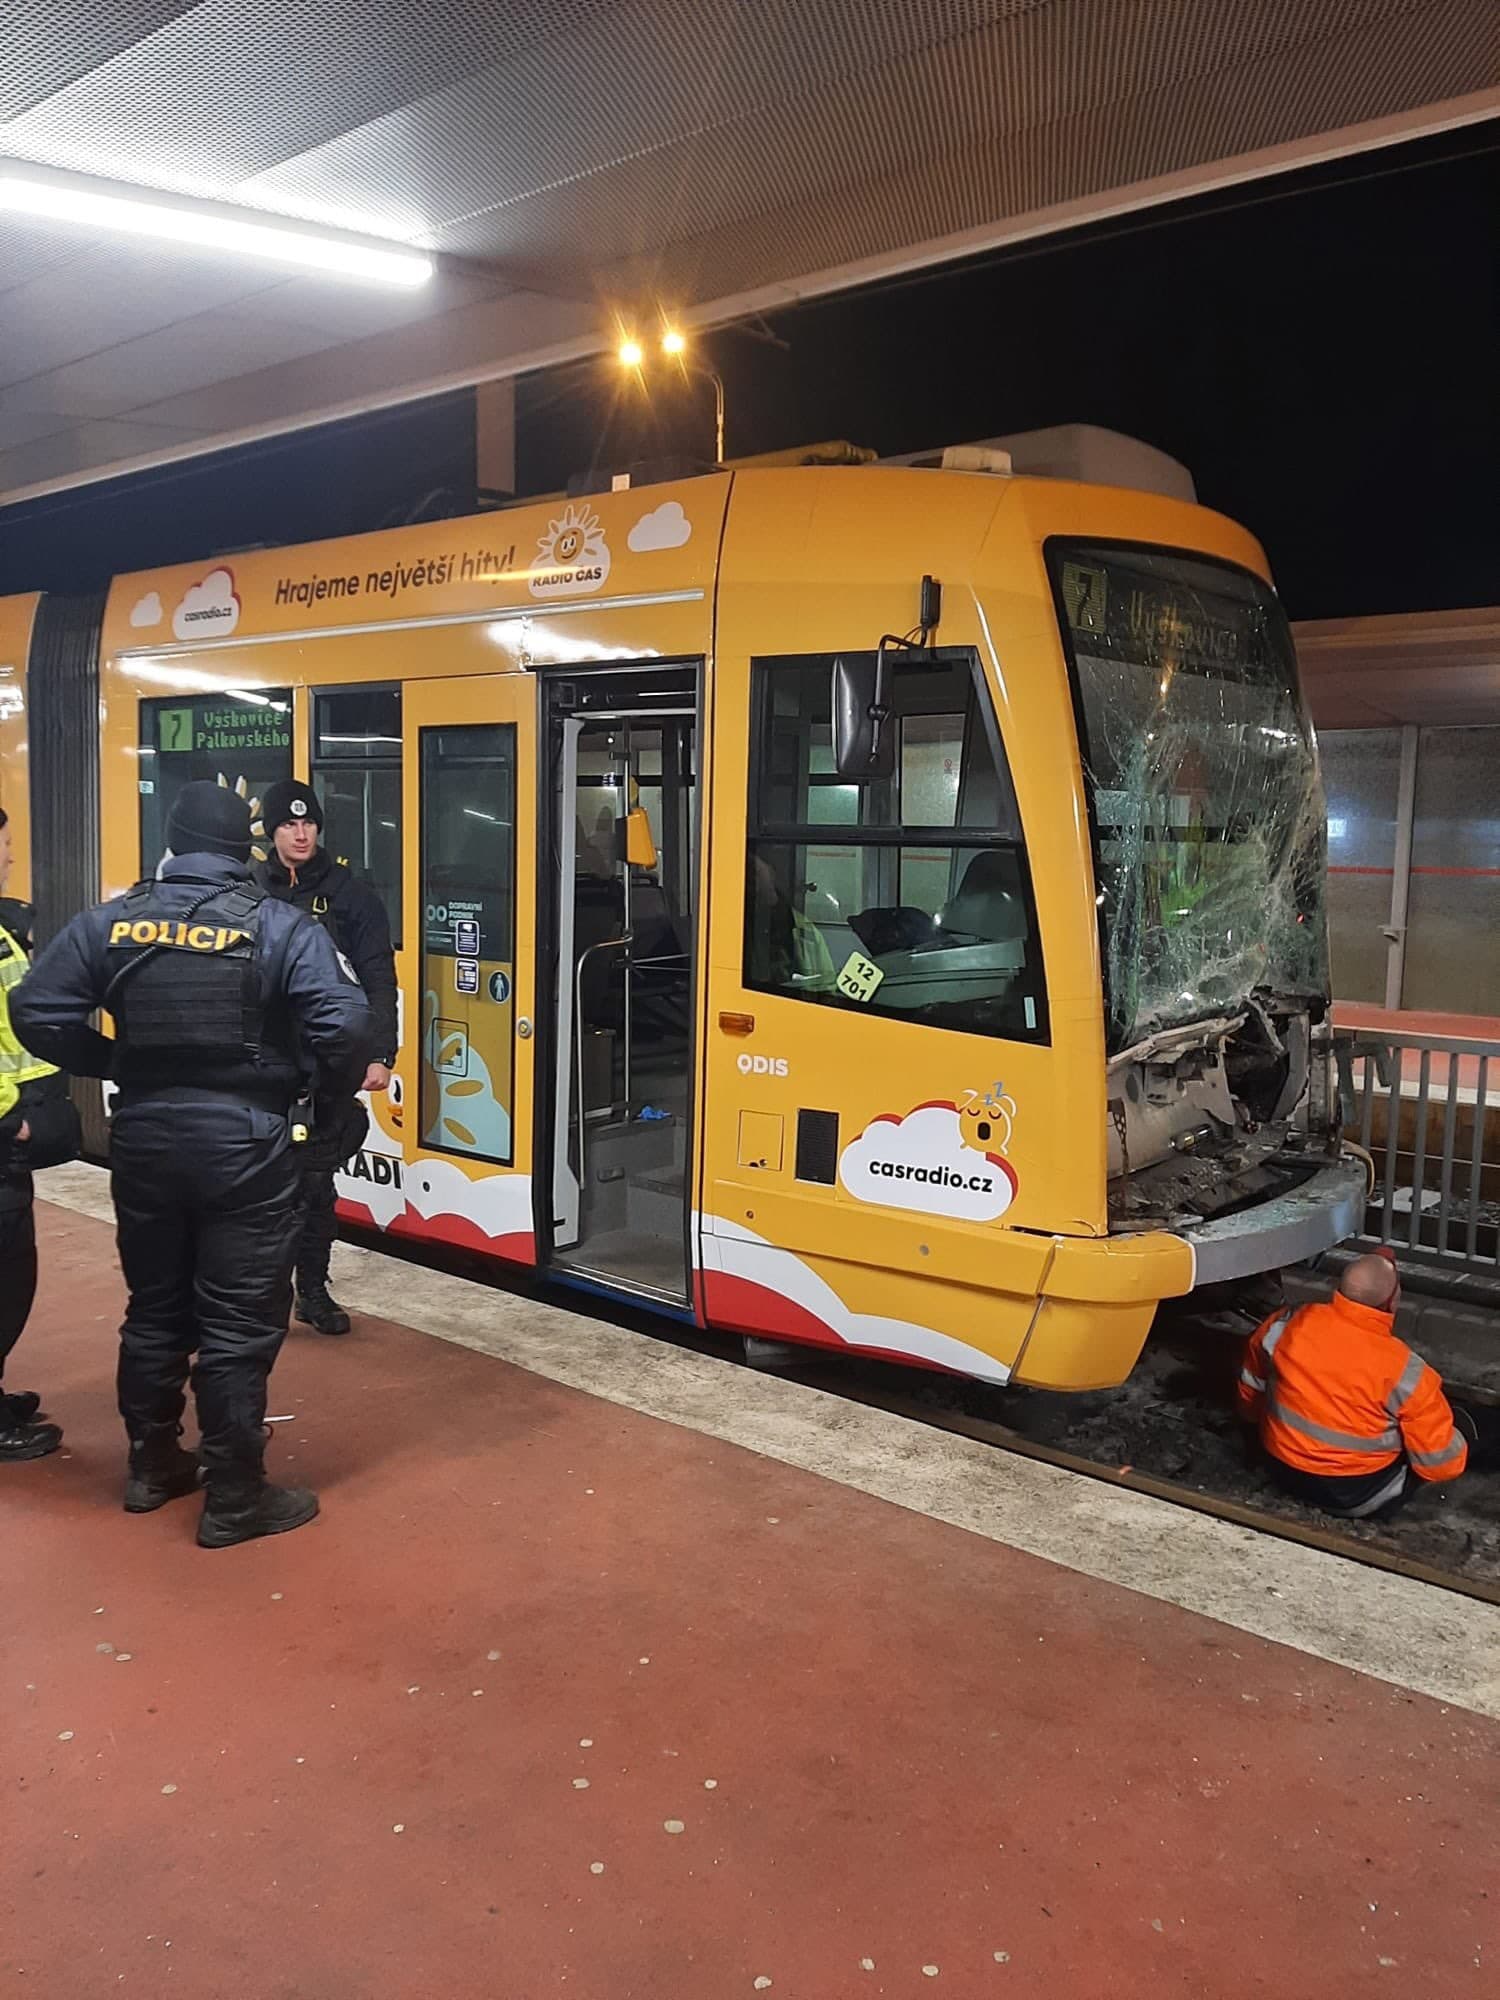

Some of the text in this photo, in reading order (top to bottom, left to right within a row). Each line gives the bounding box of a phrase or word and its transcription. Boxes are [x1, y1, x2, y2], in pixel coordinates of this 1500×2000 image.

[275, 545, 516, 608] Hrajeme největší hity!
[532, 572, 573, 587] RADIO
[1078, 571, 1093, 627] 7
[171, 713, 182, 749] 7
[203, 708, 284, 728] Vyškovice
[196, 728, 290, 749] Palkovského
[857, 962, 874, 981] 12
[841, 974, 867, 1000] 701
[868, 1160, 994, 1193] casradio.cz
